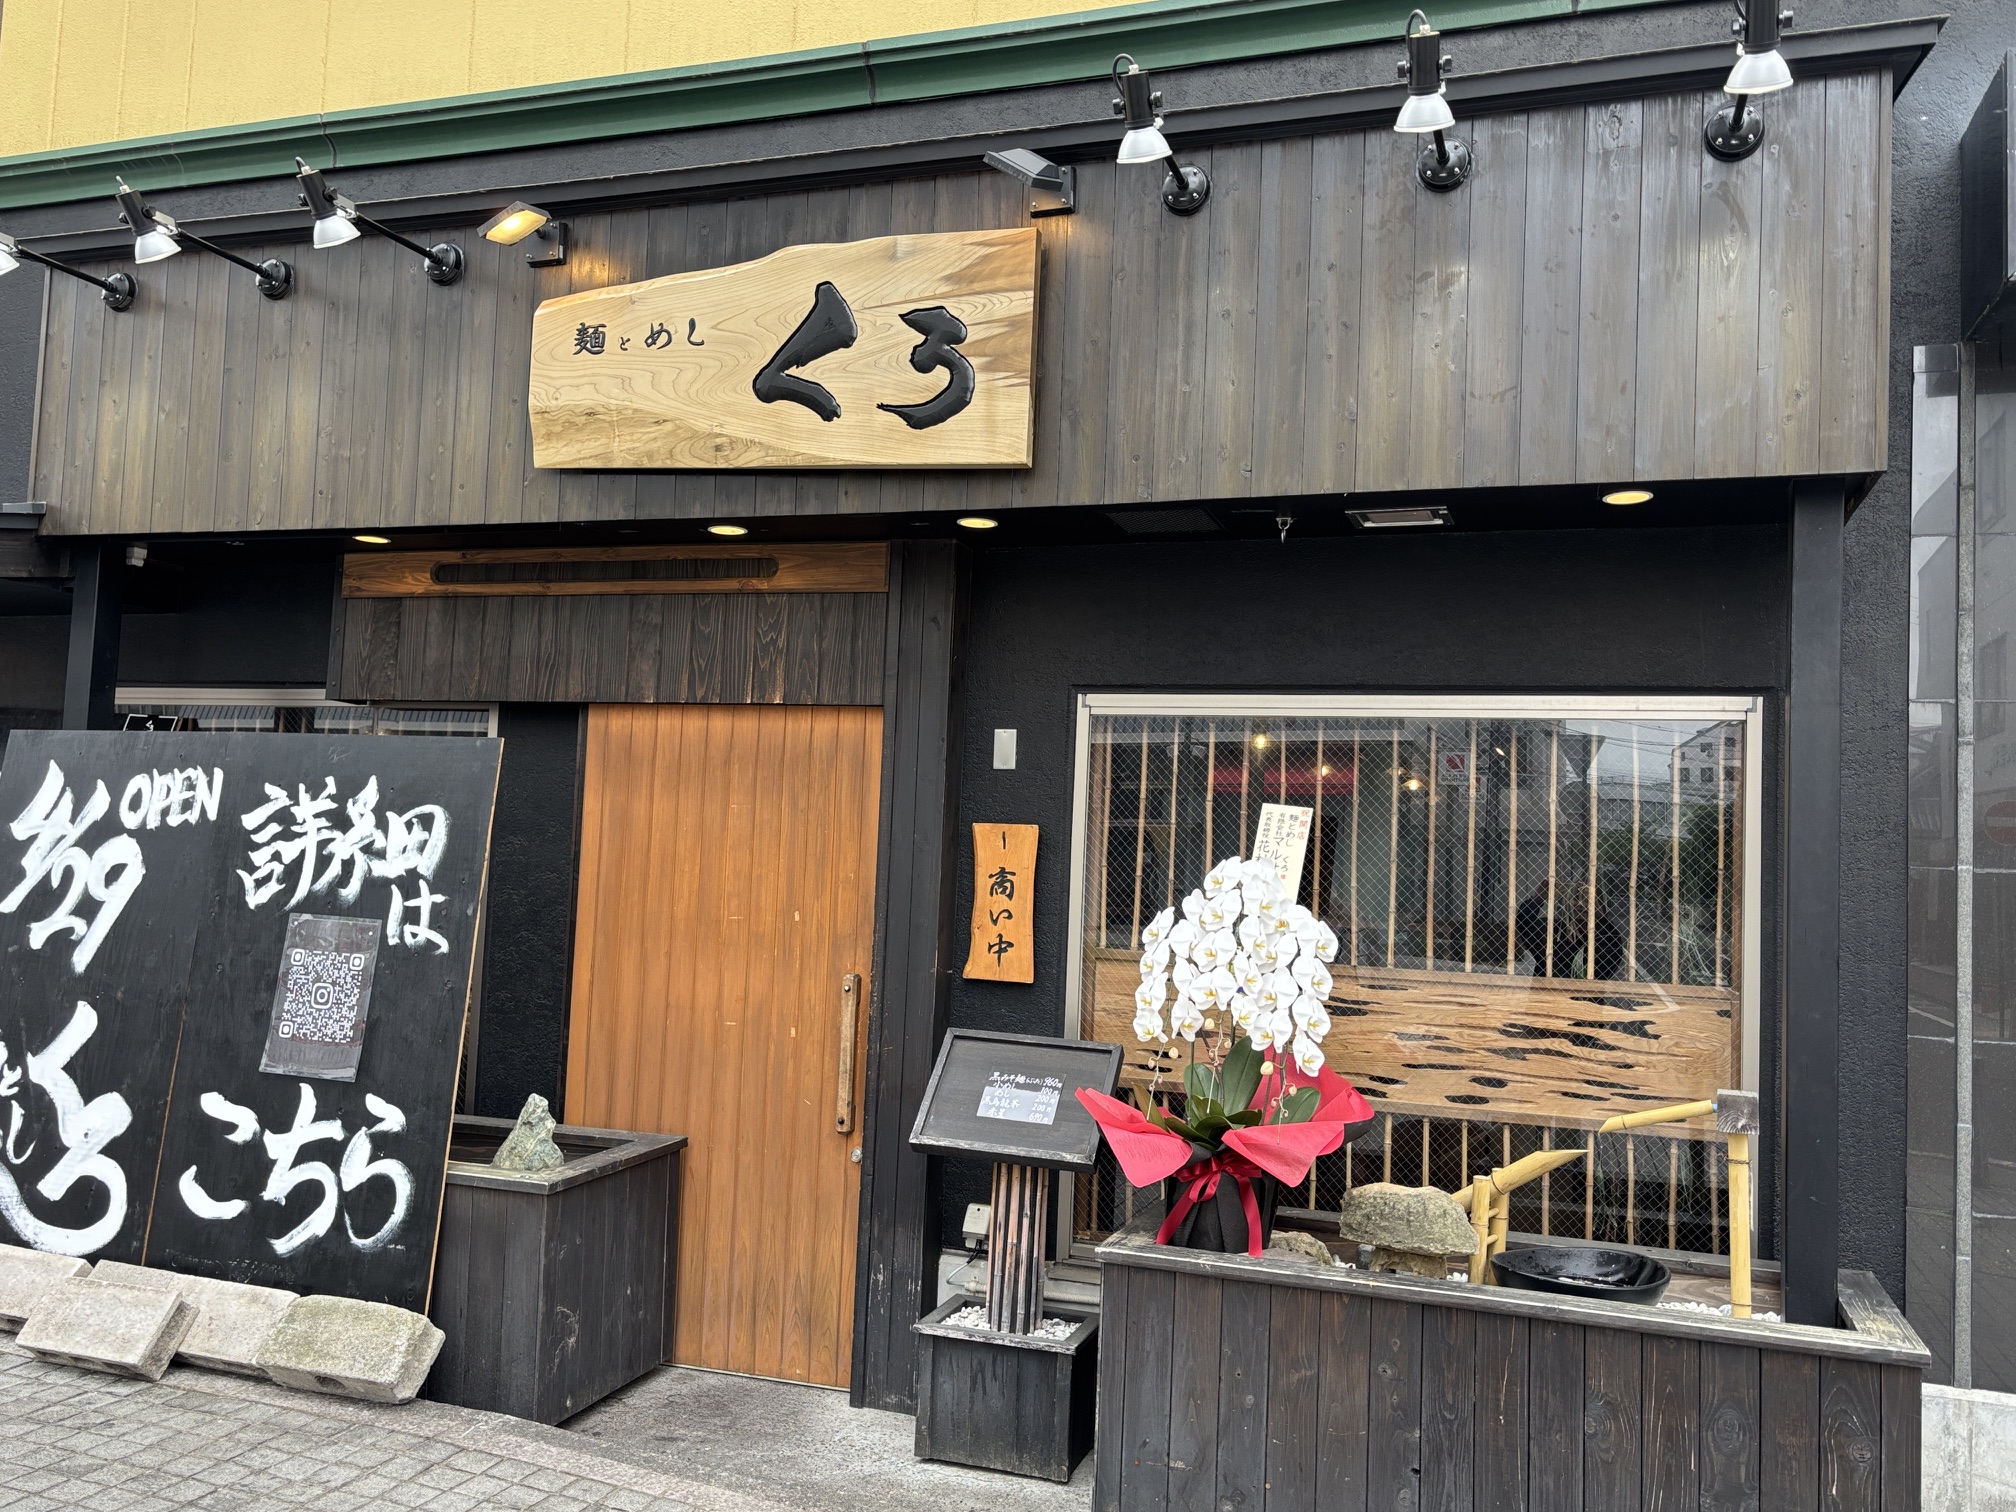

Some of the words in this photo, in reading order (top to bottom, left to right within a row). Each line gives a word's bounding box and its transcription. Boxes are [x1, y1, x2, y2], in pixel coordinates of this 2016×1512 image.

[573, 317, 705, 356] 麺とめし
[752, 281, 976, 430] くろ
[119, 765, 224, 831] OPEN
[987, 866, 1017, 967] 商い中
[179, 1083, 415, 1257] こちら
